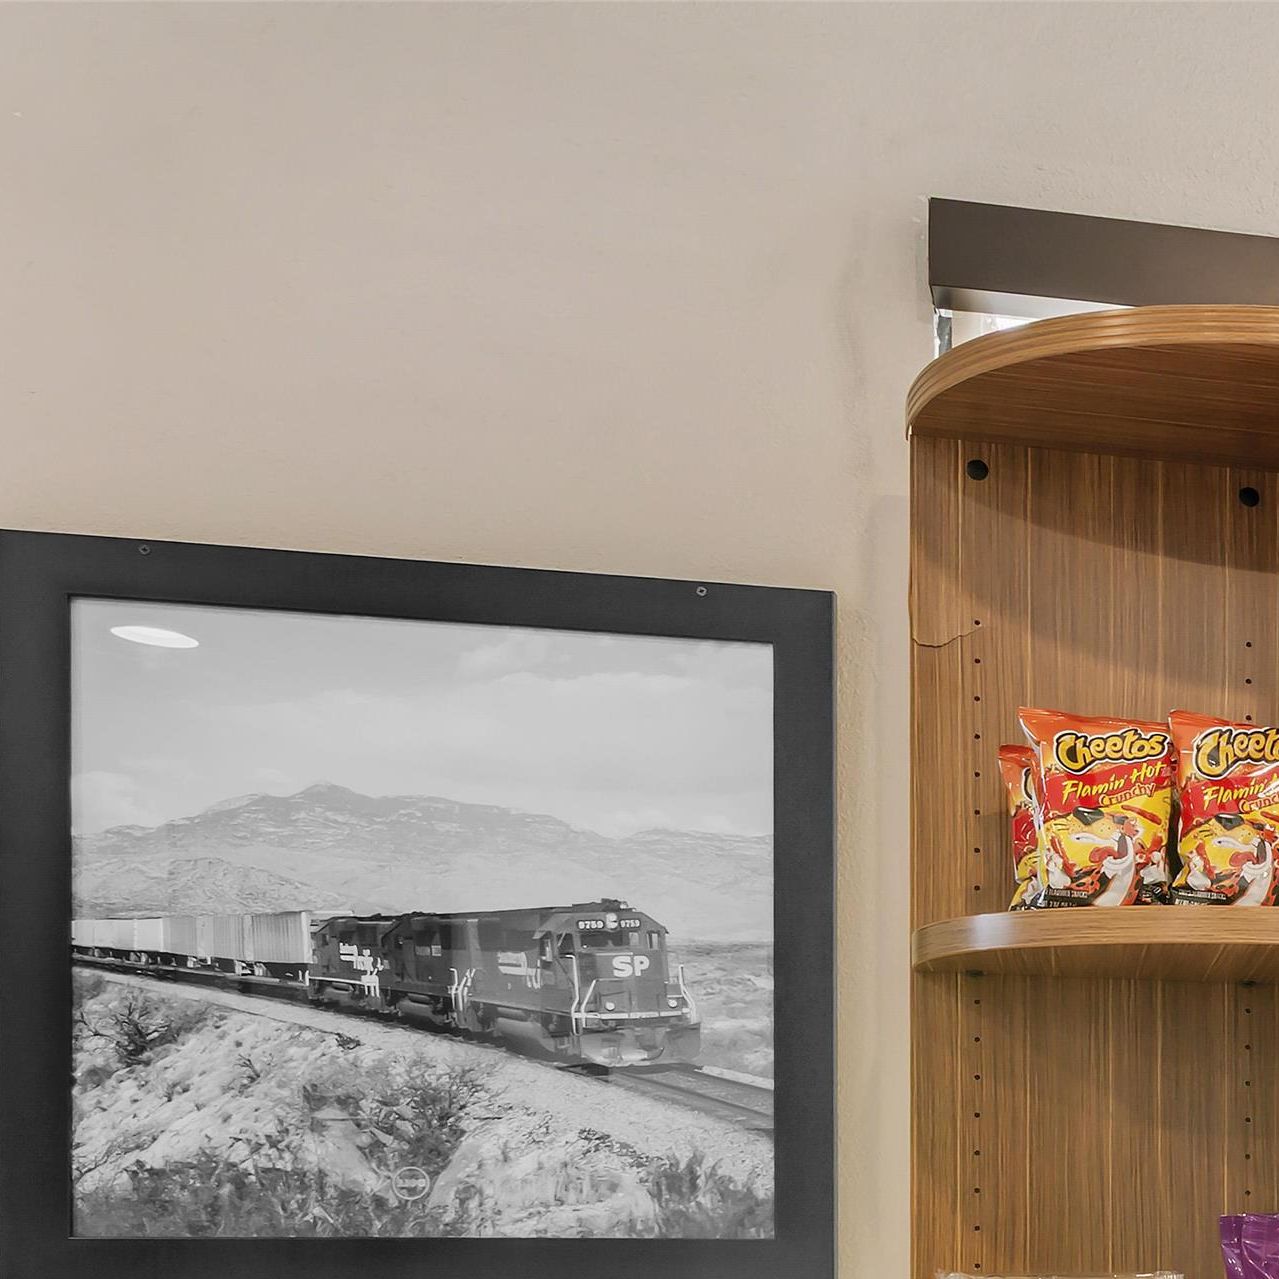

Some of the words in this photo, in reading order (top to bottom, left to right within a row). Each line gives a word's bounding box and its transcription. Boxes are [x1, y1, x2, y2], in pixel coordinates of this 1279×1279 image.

[1056, 729, 1168, 775] Cheetos
[1062, 775, 1128, 804] Flamin'
[1130, 763, 1163, 785] Hot
[1099, 781, 1157, 807] Crunchy
[1203, 778, 1267, 807] Flamin'
[612, 955, 650, 978] SP
